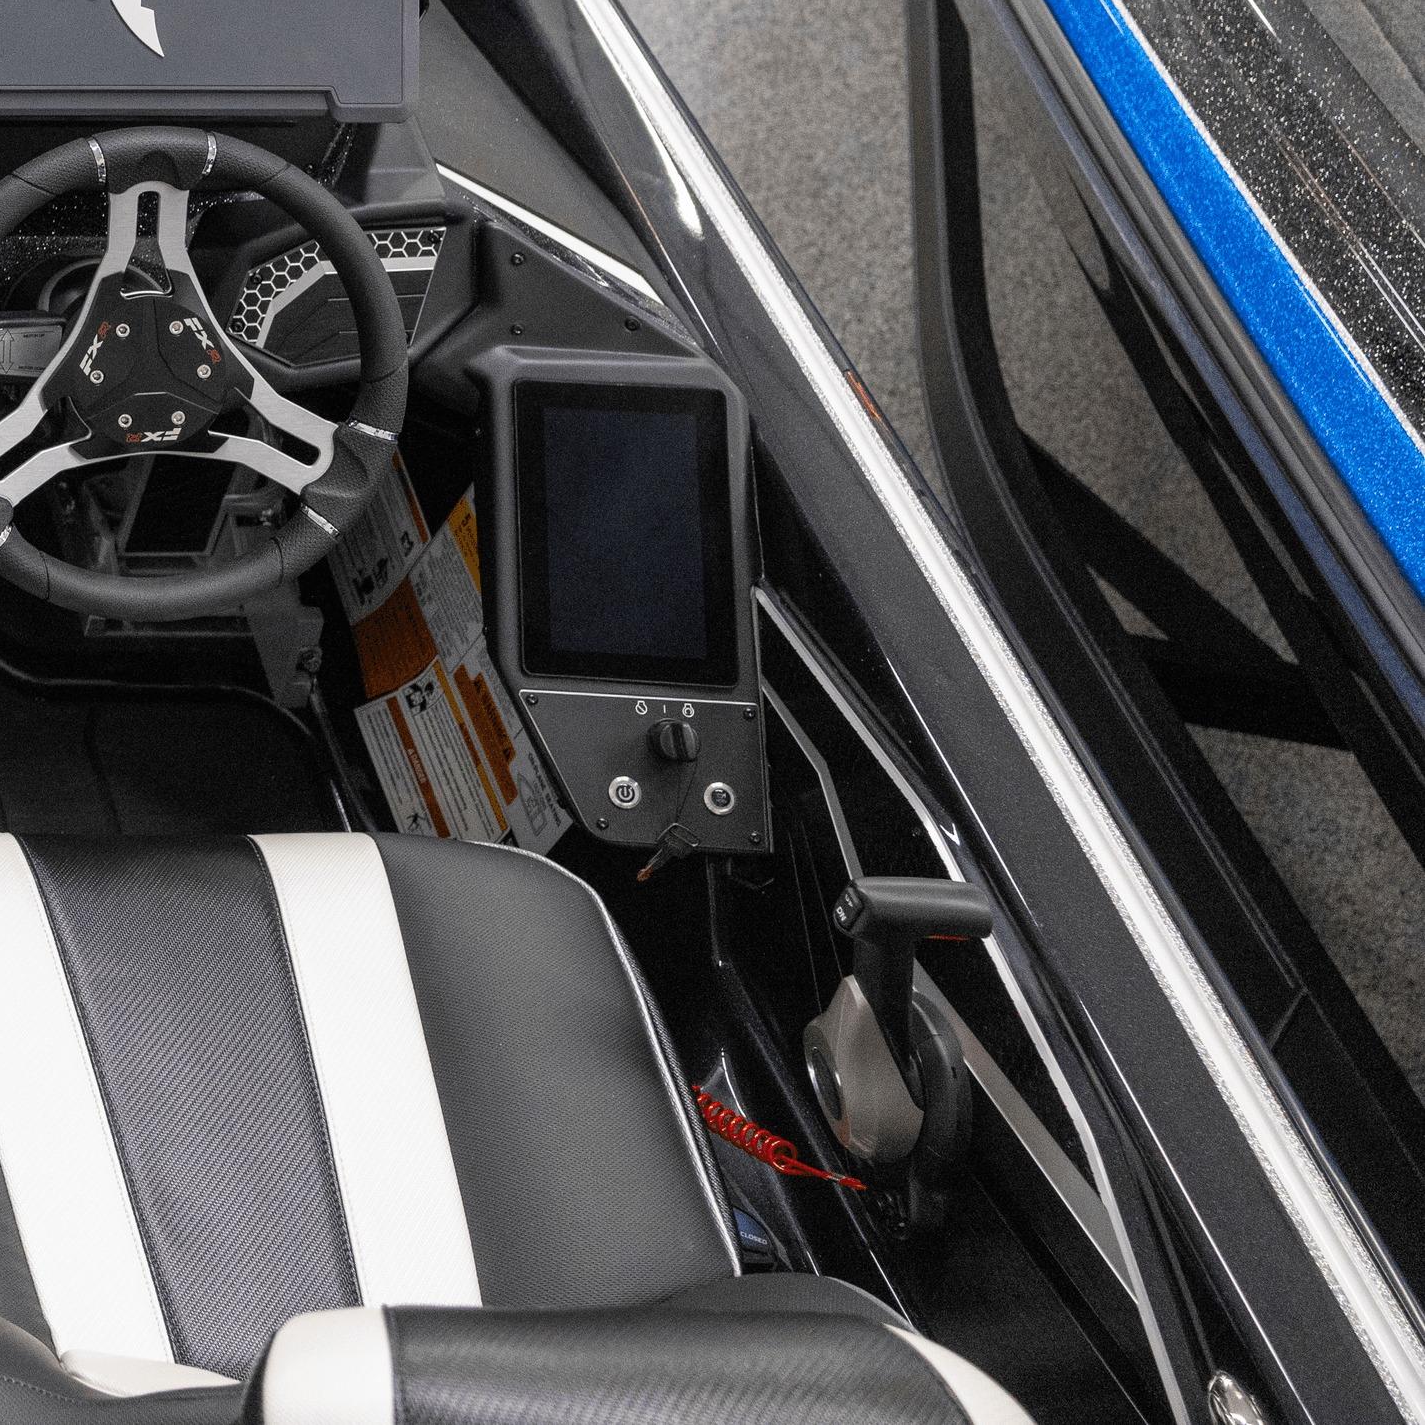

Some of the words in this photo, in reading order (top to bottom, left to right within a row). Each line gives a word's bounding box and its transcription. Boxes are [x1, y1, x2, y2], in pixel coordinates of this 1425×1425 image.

[79, 321, 112, 376] FXR
[183, 317, 222, 364] FXR
[125, 427, 182, 443] FXR
[543, 792, 563, 827] SEATING
[836, 905, 848, 922] DN
[740, 1230, 768, 1245] CLOSED
